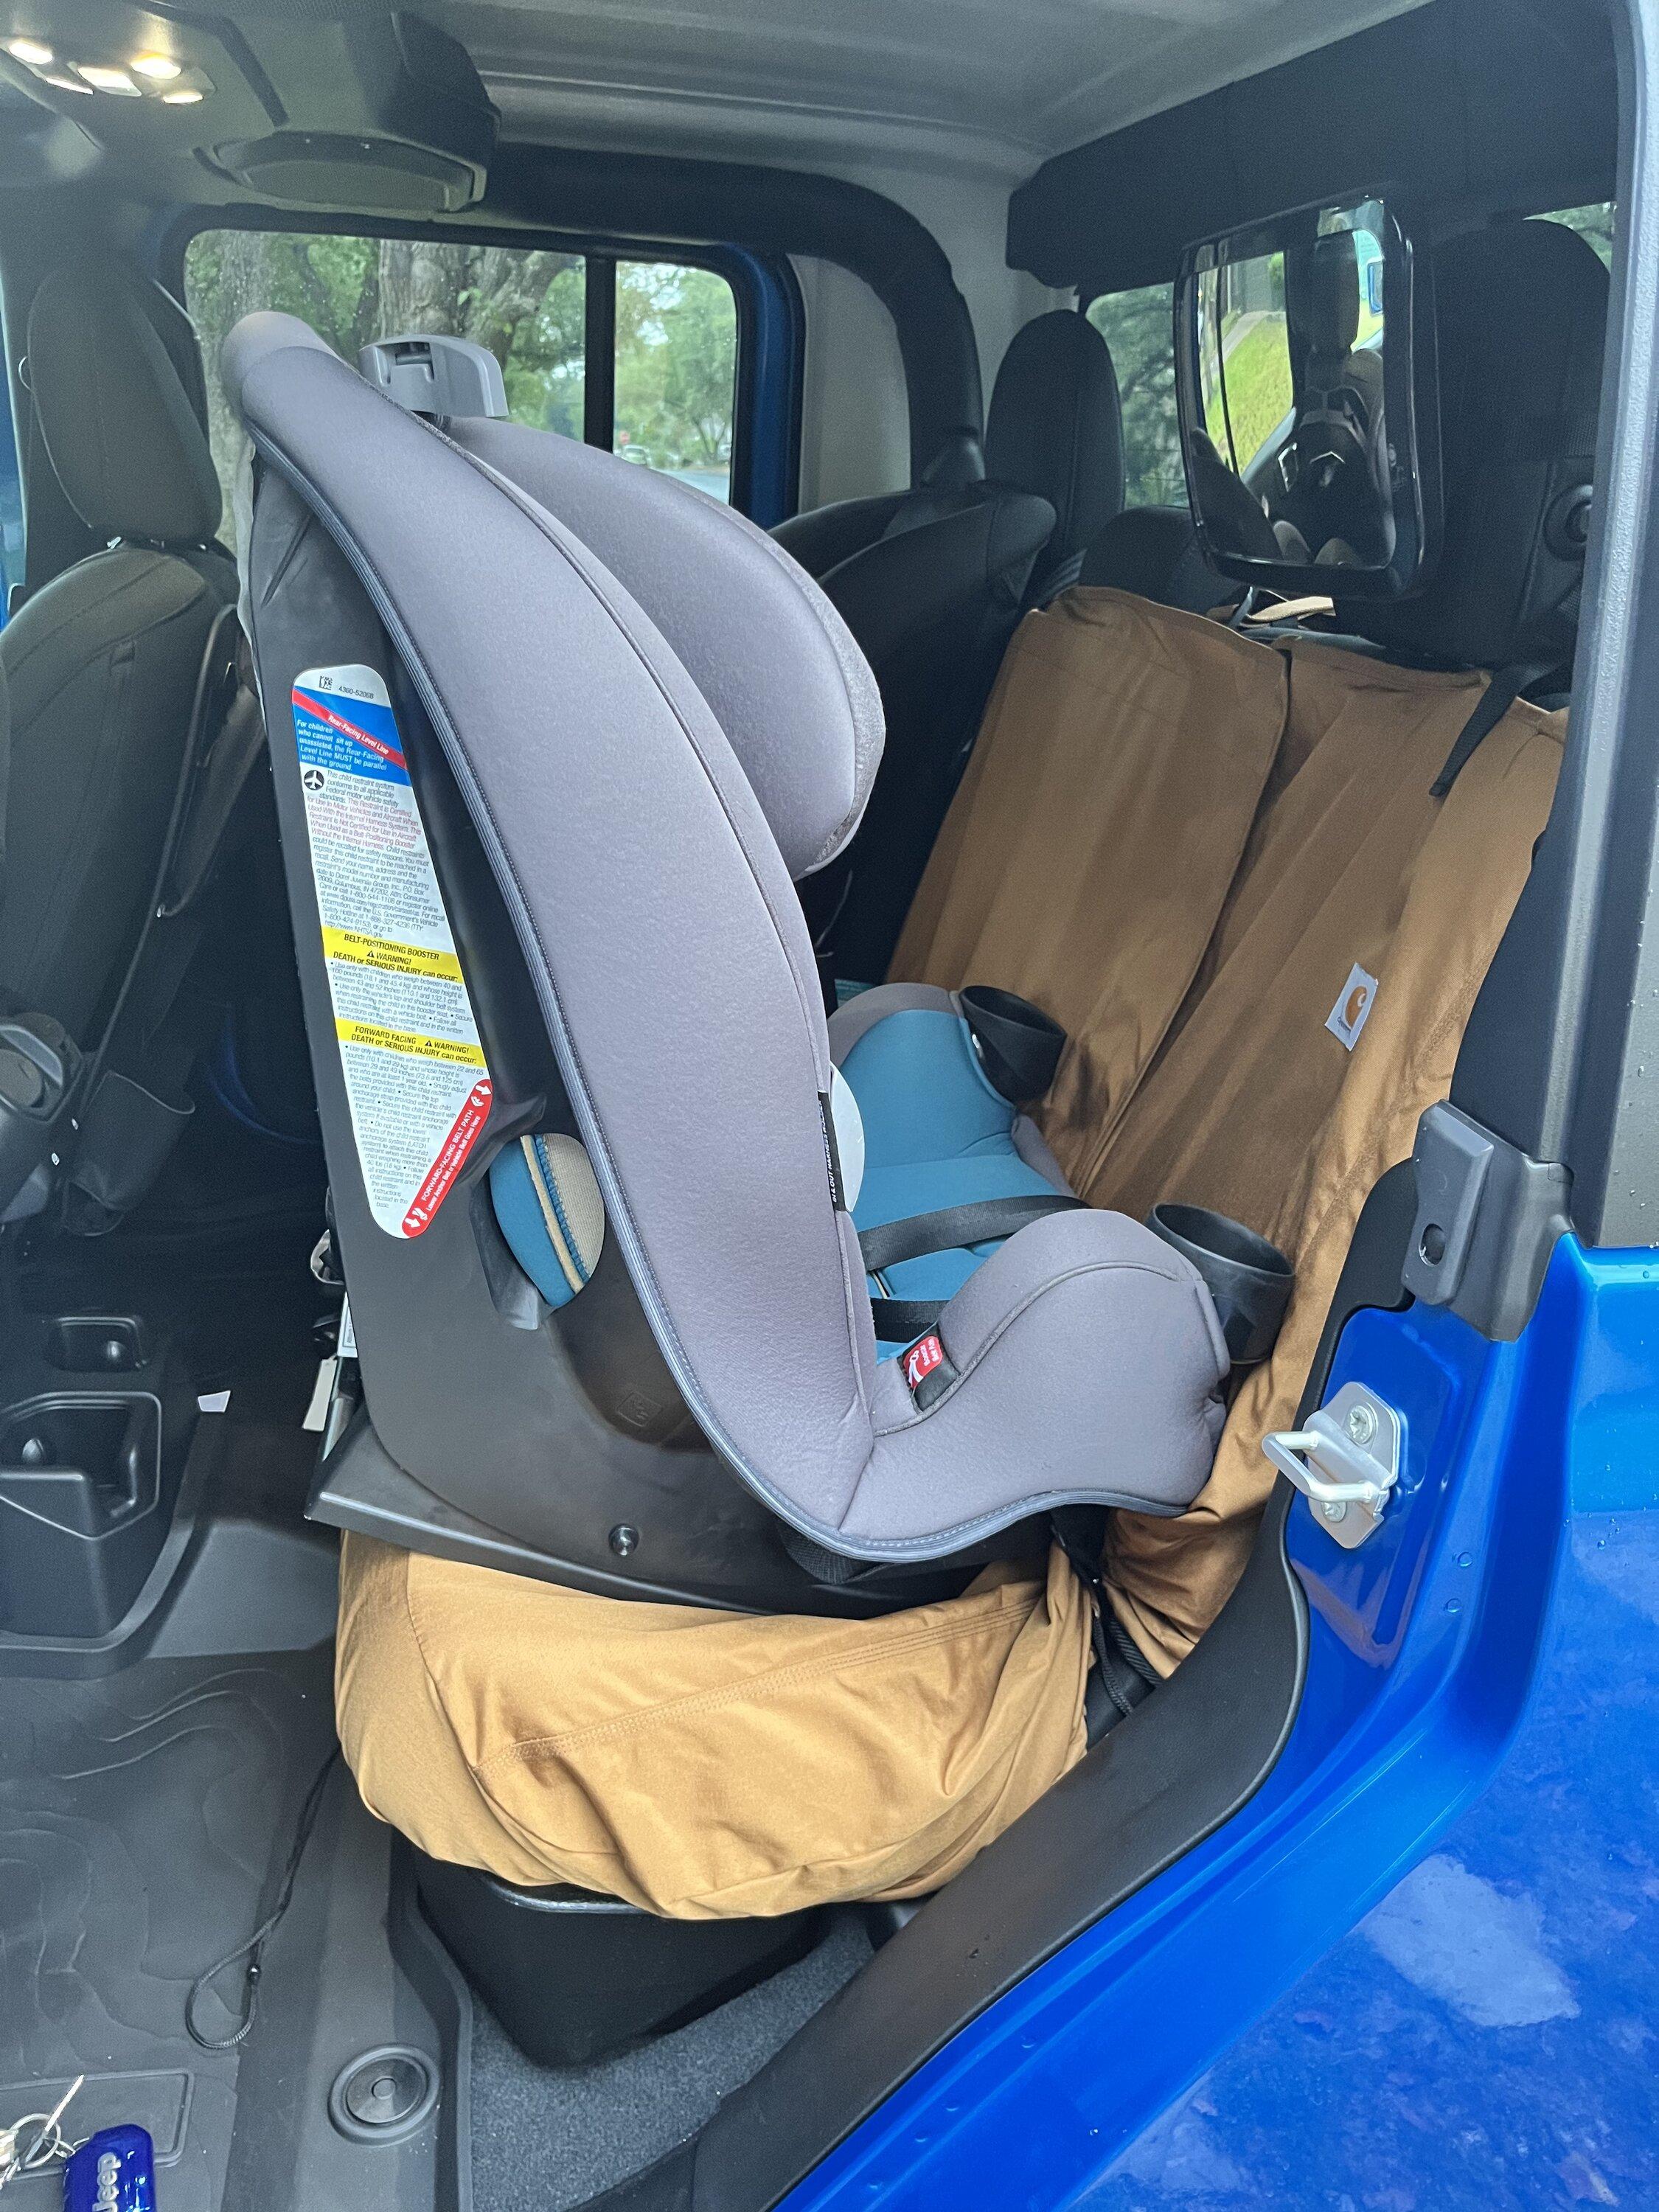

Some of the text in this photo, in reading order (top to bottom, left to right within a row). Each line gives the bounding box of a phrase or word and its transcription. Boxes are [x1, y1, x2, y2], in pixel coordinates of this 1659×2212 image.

[297, 719, 333, 734] For children
[298, 728, 311, 737] who
[313, 732, 333, 742] cannot
[328, 714, 389, 754] Rear-Facing Level Line
[300, 745, 318, 754] Level
[319, 749, 333, 758] Line
[334, 752, 352, 762] MUST
[364, 759, 387, 771] parallel
[302, 754, 316, 762] with
[329, 760, 353, 771] ground.
[347, 746, 384, 762] Rear-Facing
[344, 933, 439, 961] BELT-POSITIONING BOOSTER
[376, 951, 411, 966] WARNING!
[333, 950, 356, 962] DEATH
[365, 958, 395, 970] SERIOUS
[397, 964, 422, 976] INJURY
[351, 1033, 374, 1044] DEATH
[384, 1040, 414, 1053] SERIOUS
[414, 1046, 440, 1057] INJURY
[355, 1026, 470, 1054] FORWARD FACING WARNING!
[421, 1110, 474, 1201] FORWARD-FACING BELT PATH
[832, 1194, 837, 1203] IN
[92, 2152, 122, 2212] Jeep
